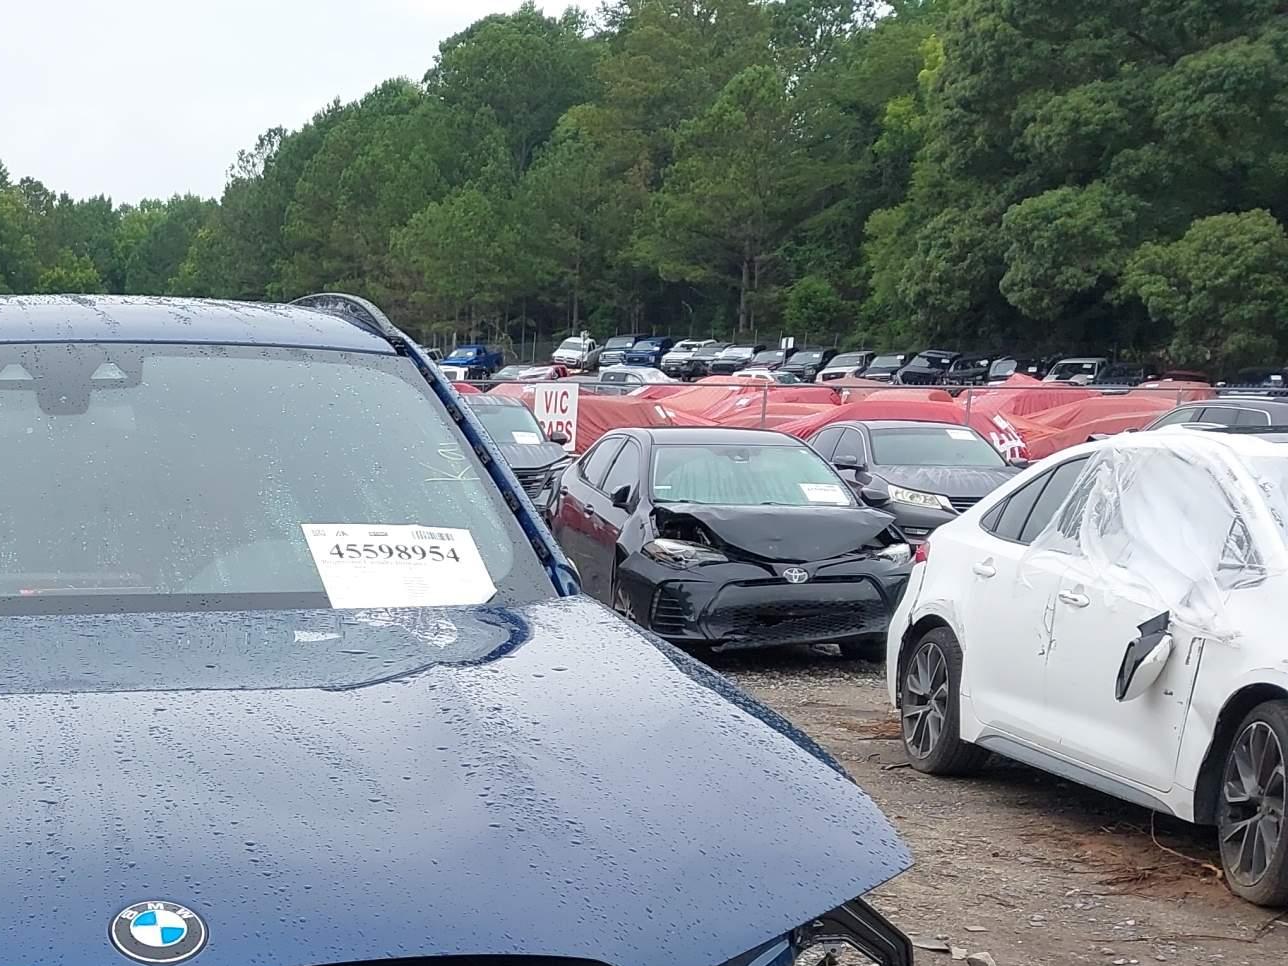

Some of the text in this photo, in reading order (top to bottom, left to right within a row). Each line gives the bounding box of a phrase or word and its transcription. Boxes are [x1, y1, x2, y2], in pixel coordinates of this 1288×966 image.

[544, 390, 569, 414] VIC
[329, 543, 461, 563] 45598954
[120, 902, 195, 920] BMW
